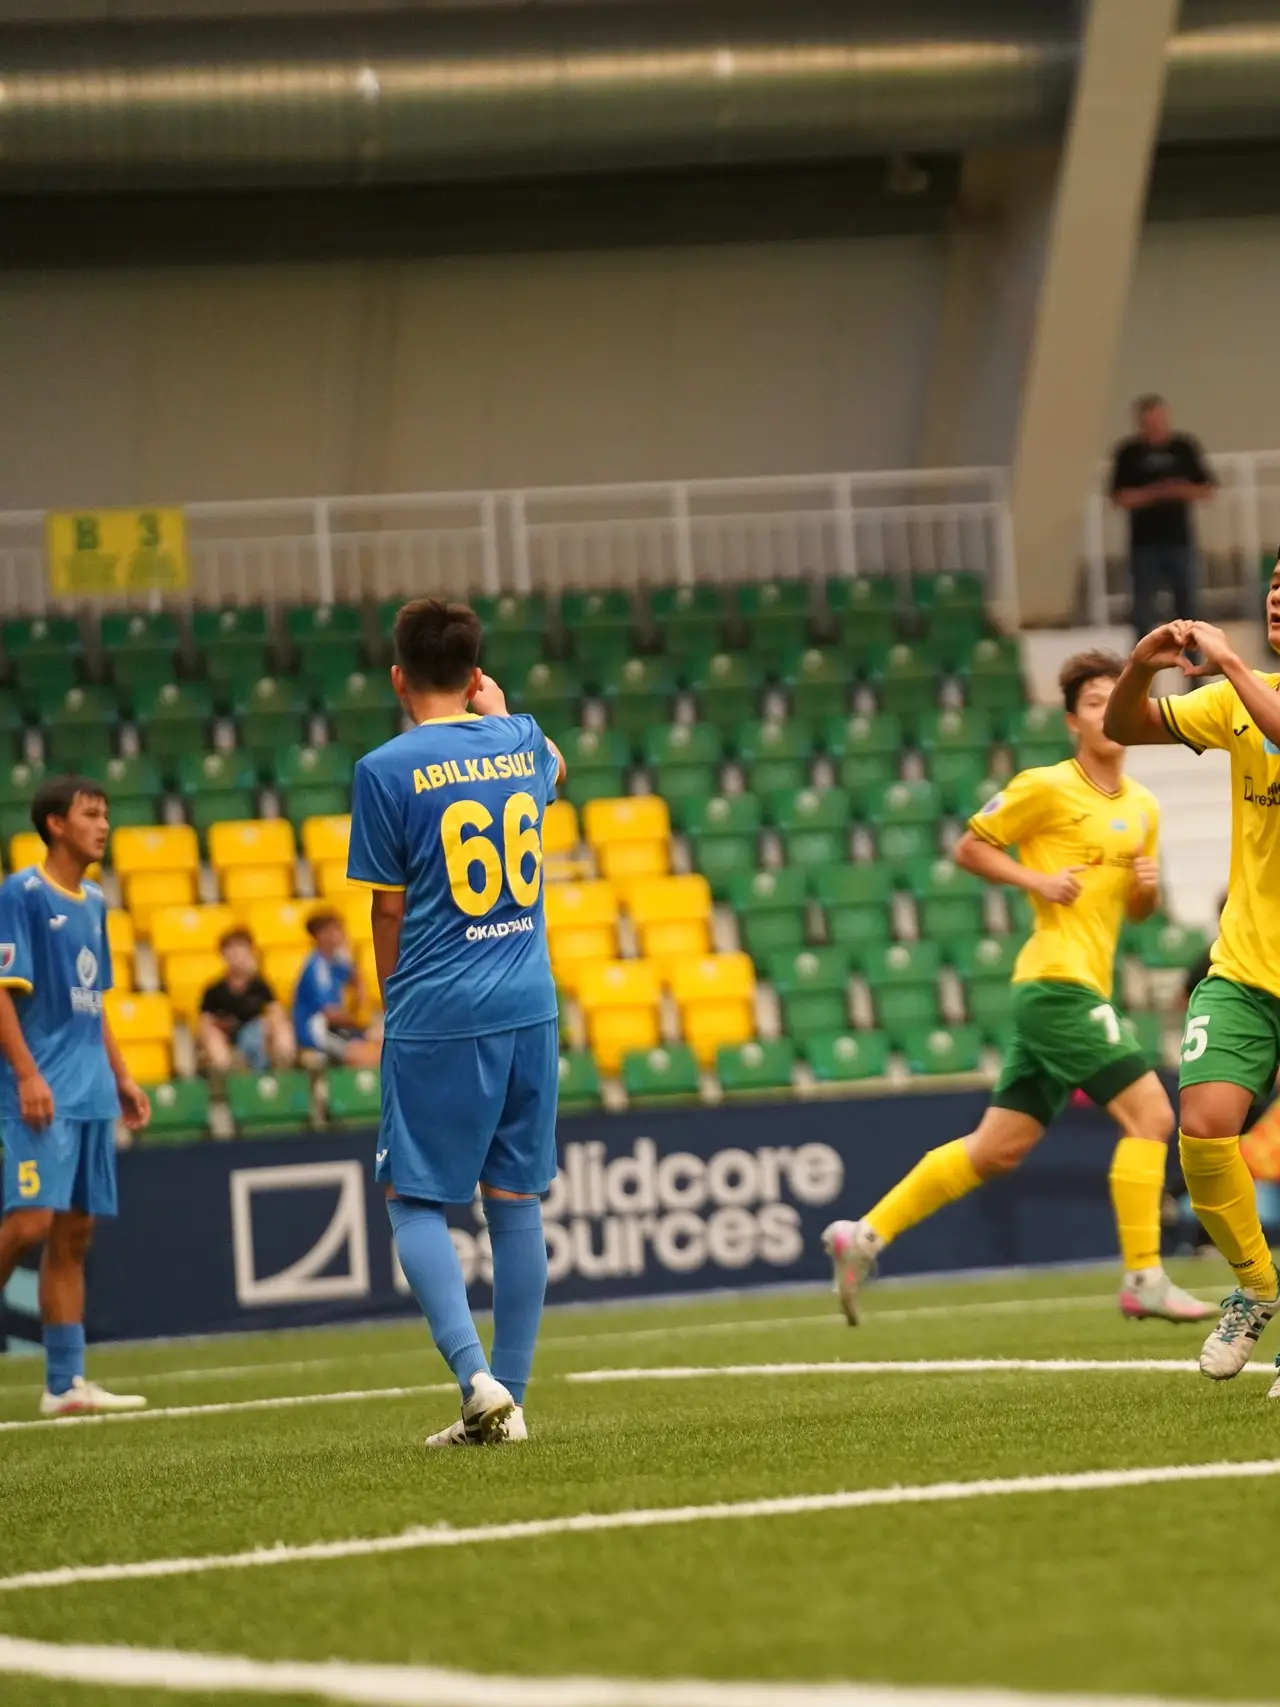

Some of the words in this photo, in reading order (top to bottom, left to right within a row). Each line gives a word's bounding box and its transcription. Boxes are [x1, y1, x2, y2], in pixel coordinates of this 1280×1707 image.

[412, 750, 537, 795] ABILKASULY
[440, 791, 543, 918] 66
[18, 1160, 41, 1199] 5
[472, 1136, 845, 1225] lidcore
